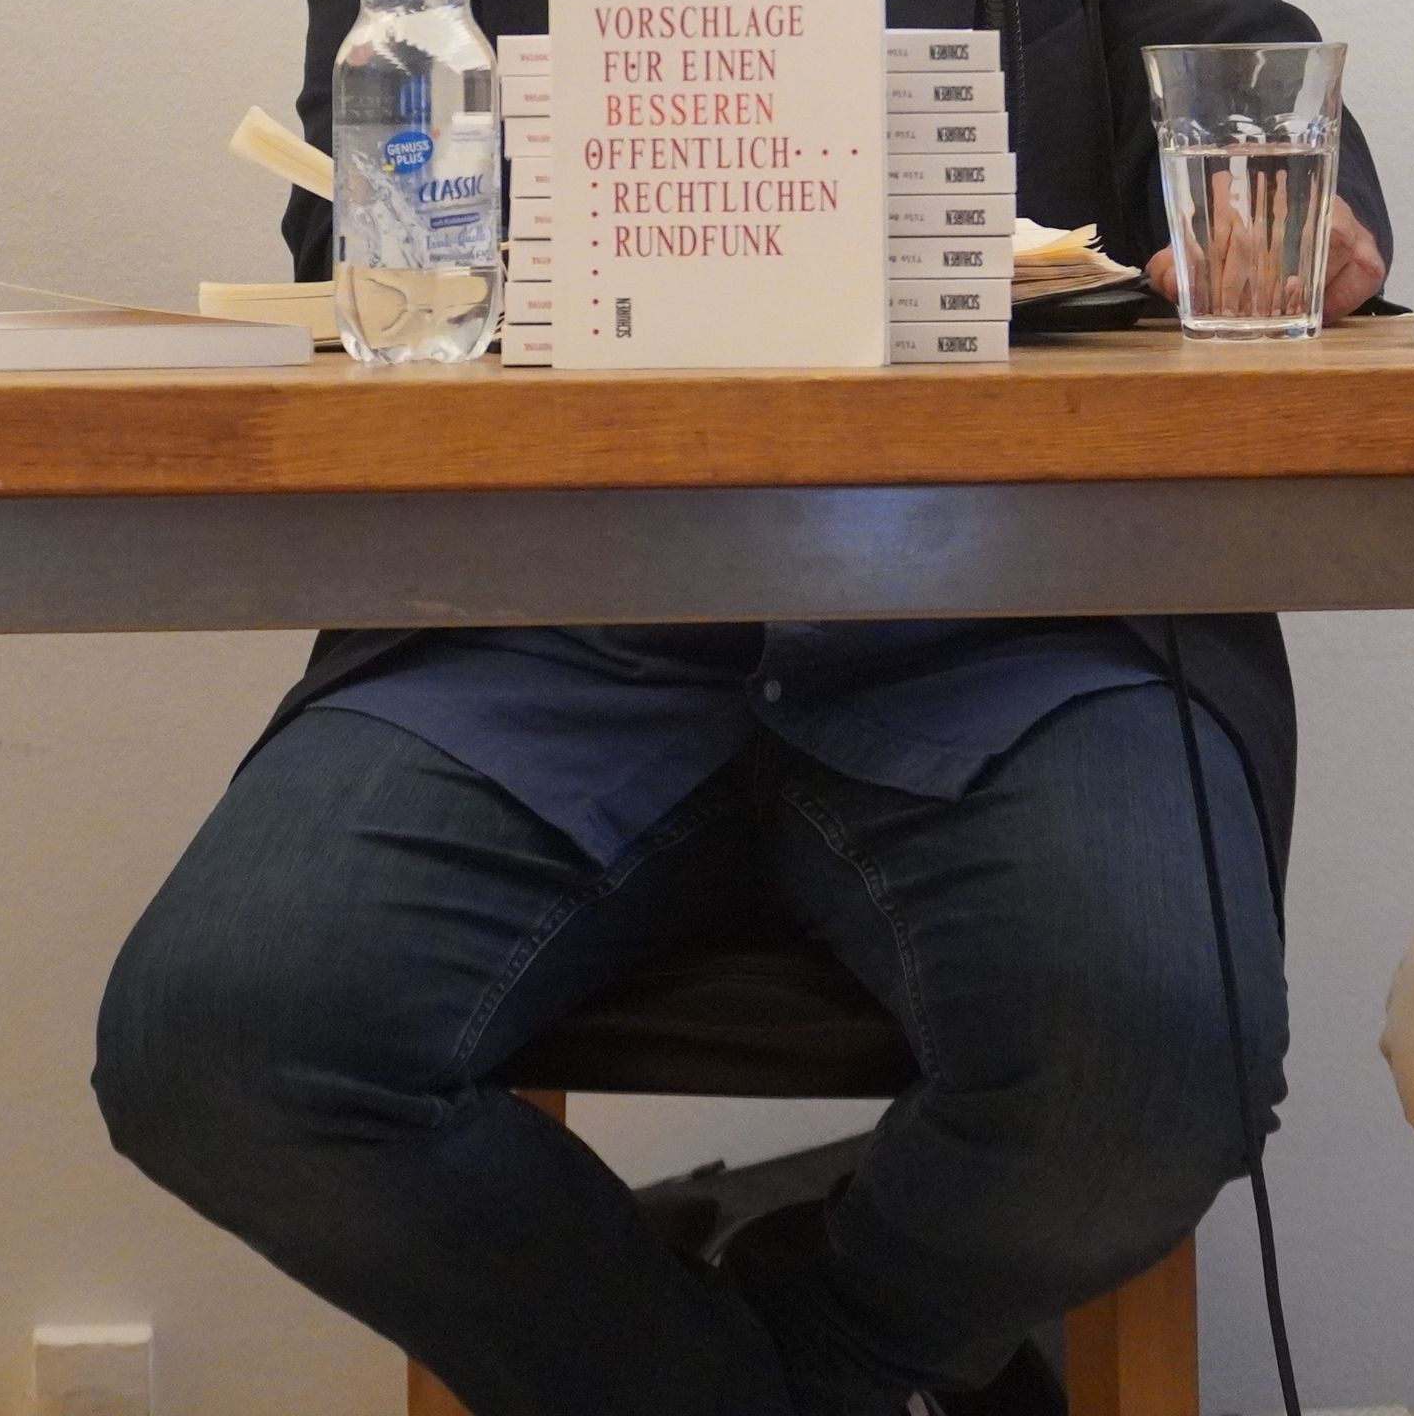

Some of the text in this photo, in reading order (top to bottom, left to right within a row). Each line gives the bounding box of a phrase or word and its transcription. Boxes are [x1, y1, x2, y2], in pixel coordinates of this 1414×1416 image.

[682, 50, 776, 82] EINEN
[606, 93, 774, 126] BESSEREN
[387, 140, 430, 156] GENUSS
[396, 153, 424, 165] PLUS
[419, 175, 484, 203] CLASSIC
[613, 180, 838, 214] RECHTLICHEN
[614, 224, 784, 257] RUNDFUNK
